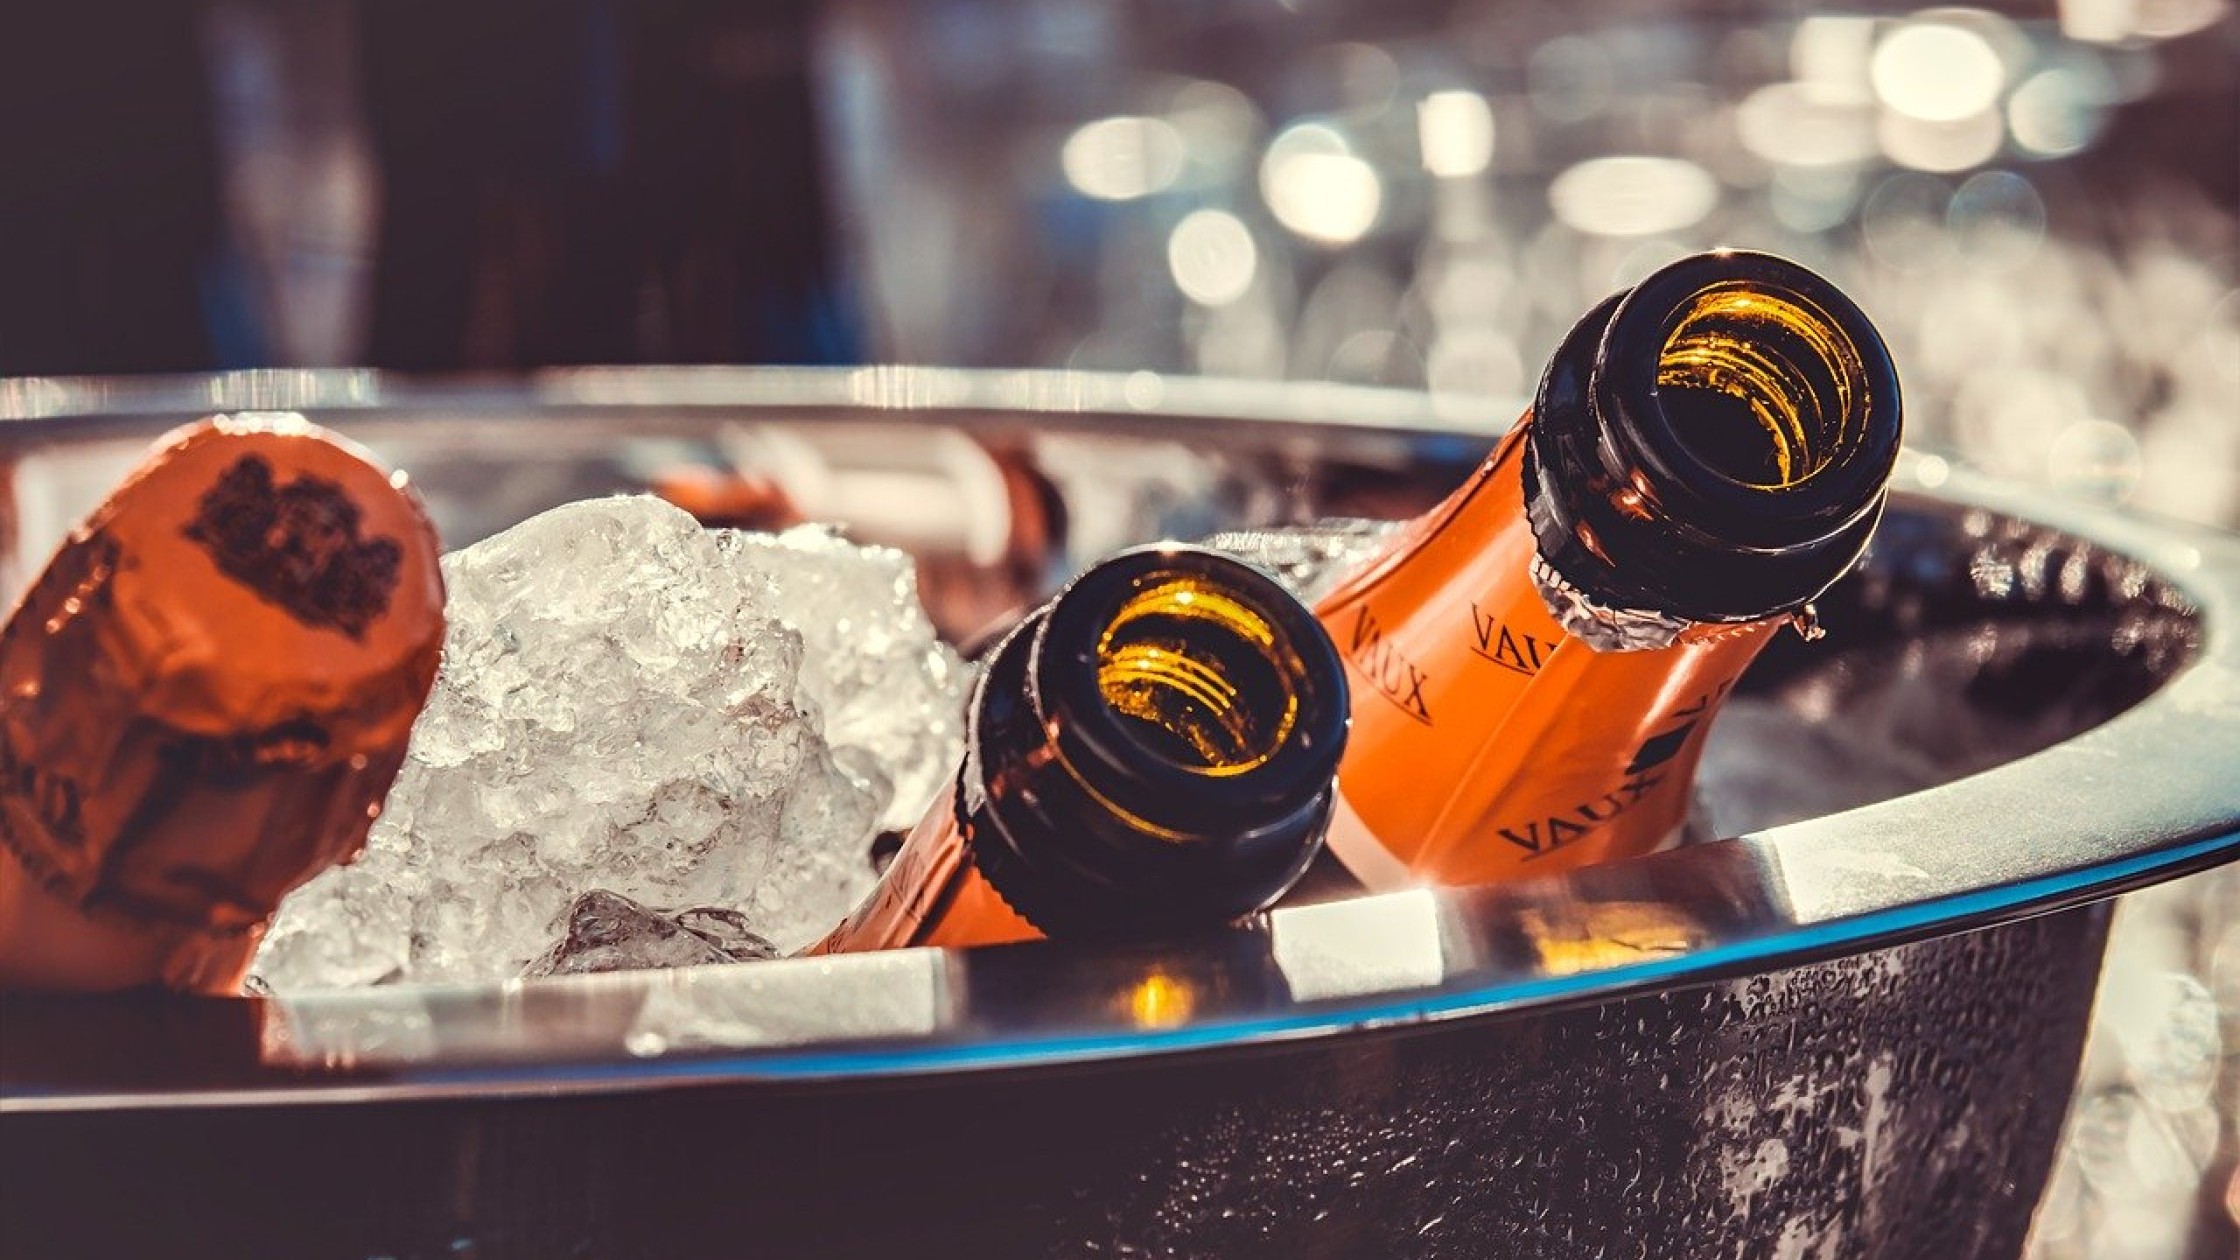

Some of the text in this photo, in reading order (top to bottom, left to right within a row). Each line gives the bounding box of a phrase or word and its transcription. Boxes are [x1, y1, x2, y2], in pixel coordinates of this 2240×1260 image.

[1352, 604, 1430, 718] VAUX
[1471, 602, 1557, 670] VAU
[1497, 771, 1665, 853] VAUX
